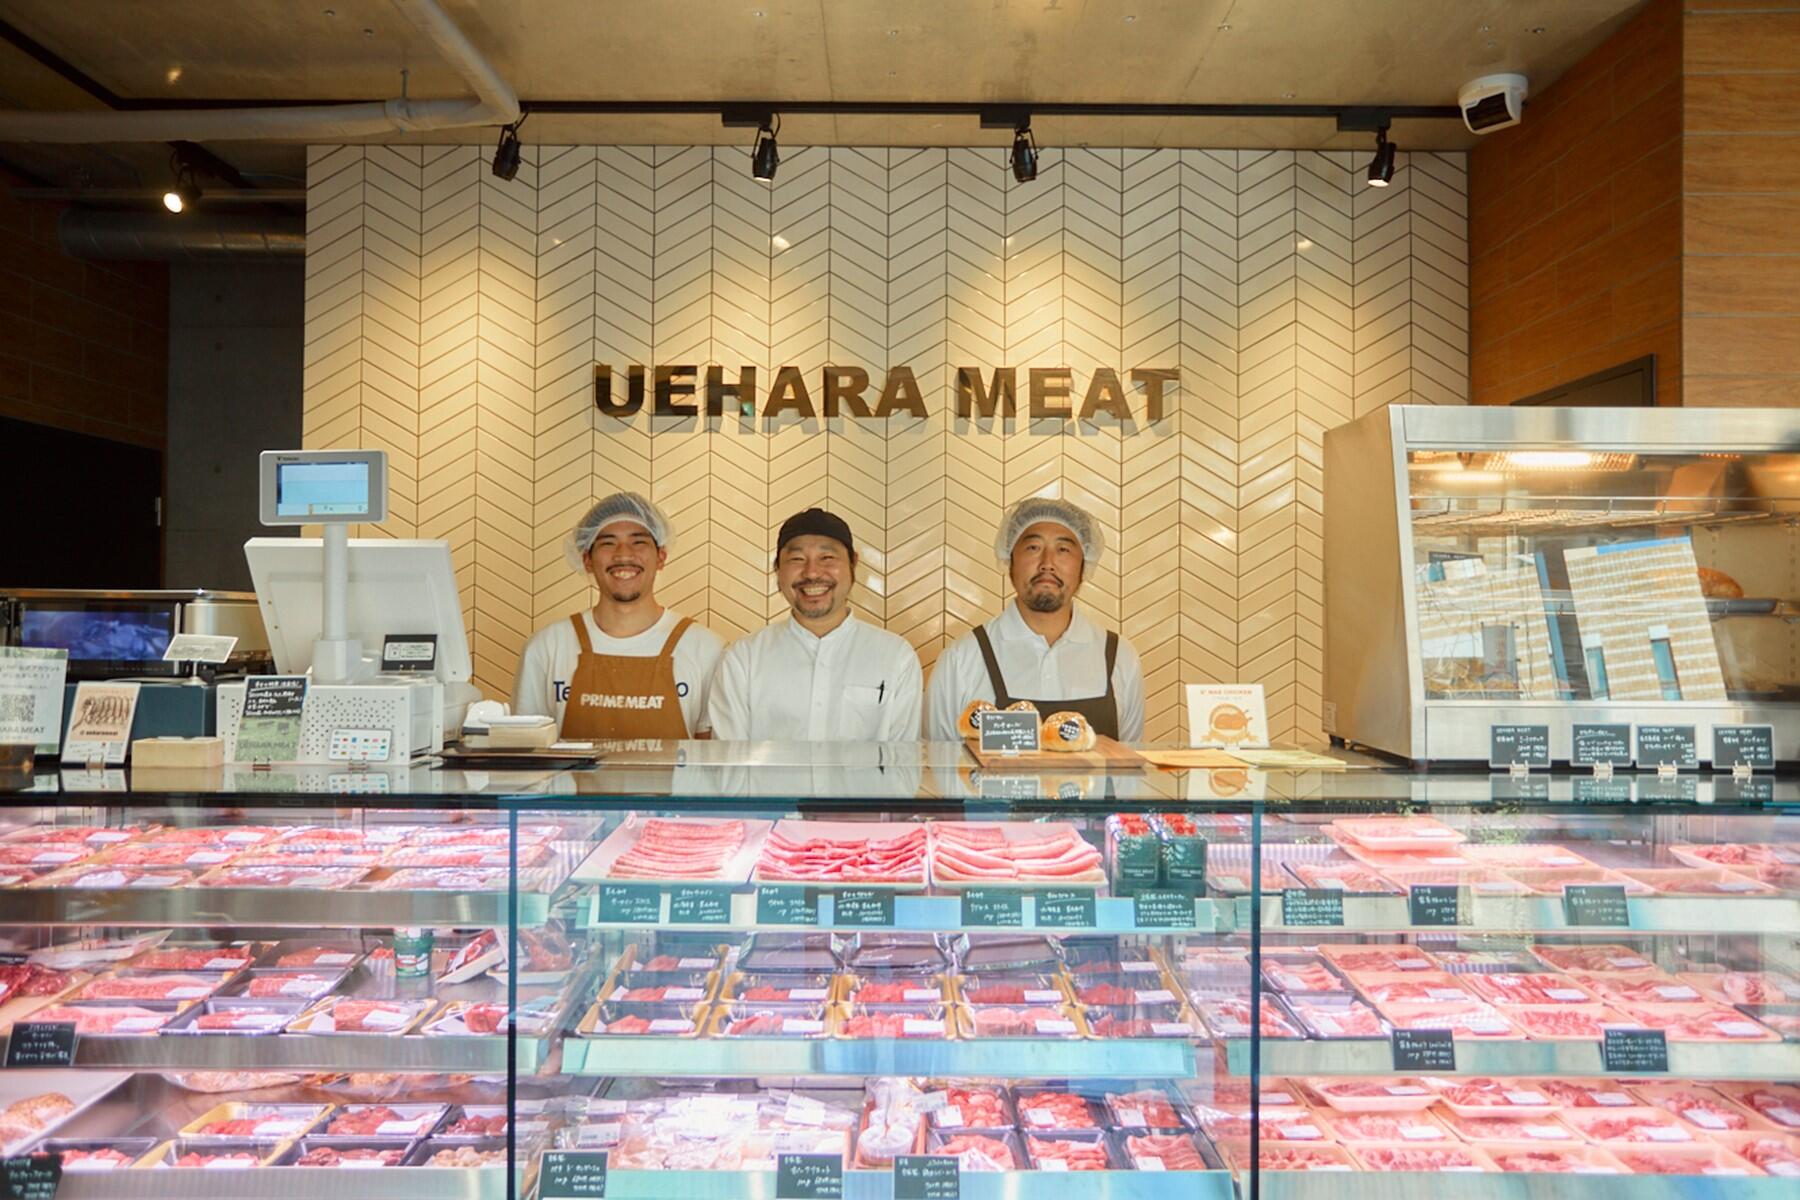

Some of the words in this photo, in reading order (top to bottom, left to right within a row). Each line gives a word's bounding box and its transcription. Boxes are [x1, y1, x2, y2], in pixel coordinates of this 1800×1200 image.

[593, 365, 929, 418] UEHARA
[957, 366, 1180, 418] MEAT
[580, 693, 665, 709] PRIMEMEAT
